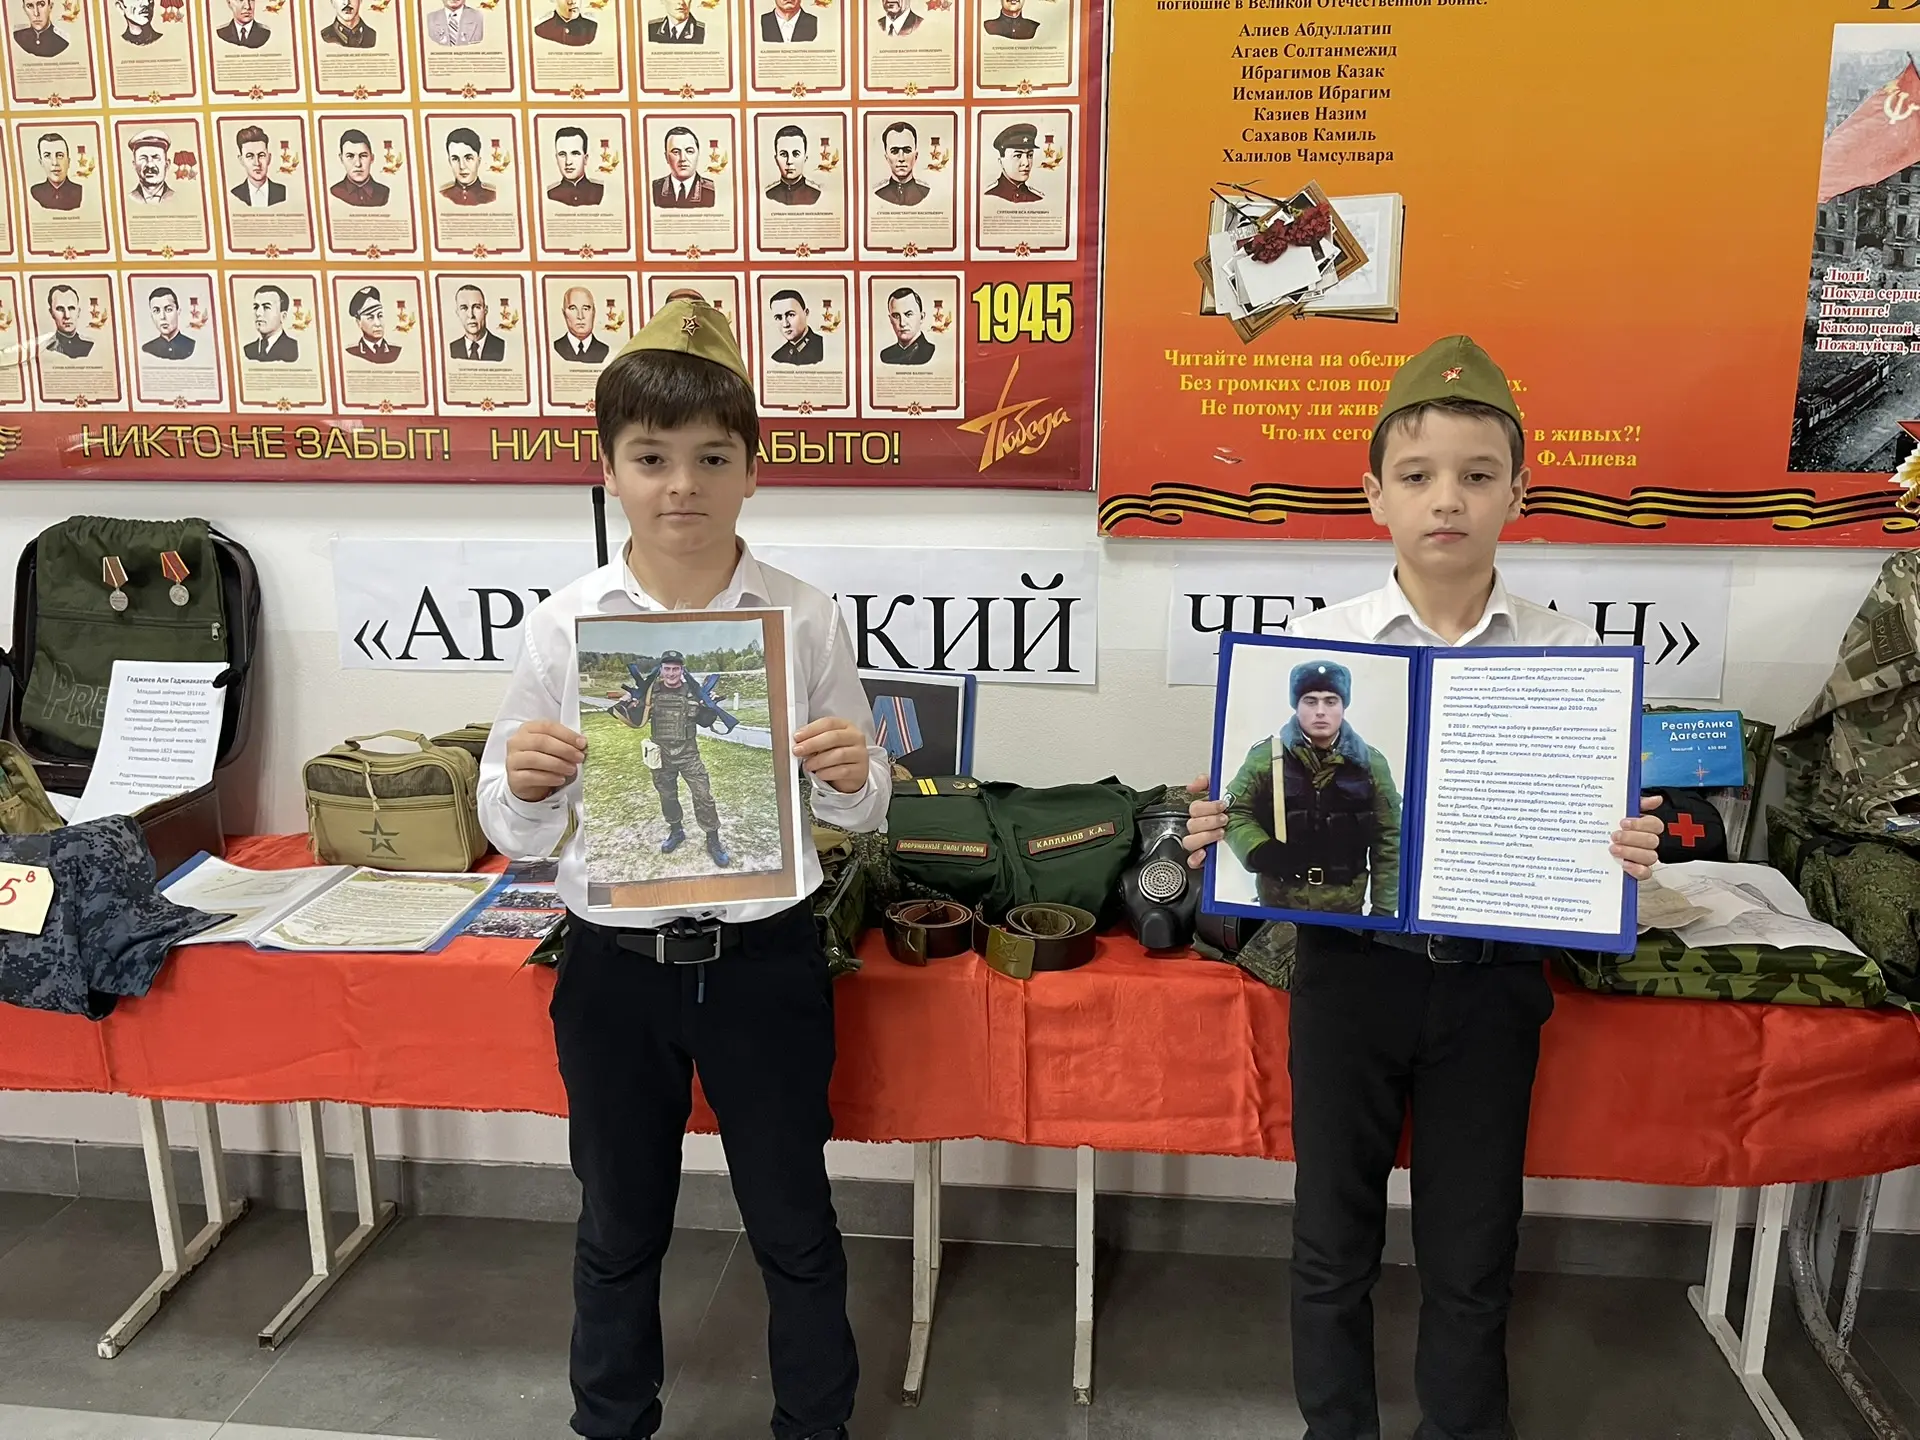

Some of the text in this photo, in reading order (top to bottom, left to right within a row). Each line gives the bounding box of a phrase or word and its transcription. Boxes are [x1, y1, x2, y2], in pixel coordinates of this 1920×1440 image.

[1239, 22, 1392, 39] Алиев Абдуллатип
[1231, 44, 1397, 58] Агаев Солтанмежид
[1241, 64, 1385, 83] Ибрагимов Казак
[1233, 86, 1390, 103] Исмаилов Ибрагим
[1254, 107, 1367, 120] Казиев Назим
[1242, 128, 1376, 142] Сахавов Камиль
[1223, 149, 1394, 165] Халилов Чамсулвара
[1823, 267, 1871, 284] Люди!
[1822, 286, 1875, 302] Покуда
[971, 282, 1074, 343] 1945
[1820, 303, 1890, 317] Помните!
[1817, 320, 1867, 334] Какою
[1869, 322, 1913, 336] ценой
[1816, 337, 1908, 355] Пожалуйста,
[1164, 350, 1247, 366] Читайте
[1253, 354, 1312, 367] имена
[1320, 354, 1342, 367] на
[1180, 375, 1391, 394] Без громких слов под
[1201, 399, 1384, 420] Не потому ли жив
[1261, 424, 1641, 441] Что их сего в живых?!
[81, 425, 900, 465] НИКТО НЕ ЗАБЫТ! НИЧТ БЫТО!
[1537, 450, 1636, 466] Ф.Алиева
[1662, 720, 1733, 731] Республика
[1670, 731, 1726, 741] Дагестан
[1036, 827, 1106, 848] КАПЛАНОВ К.А.
